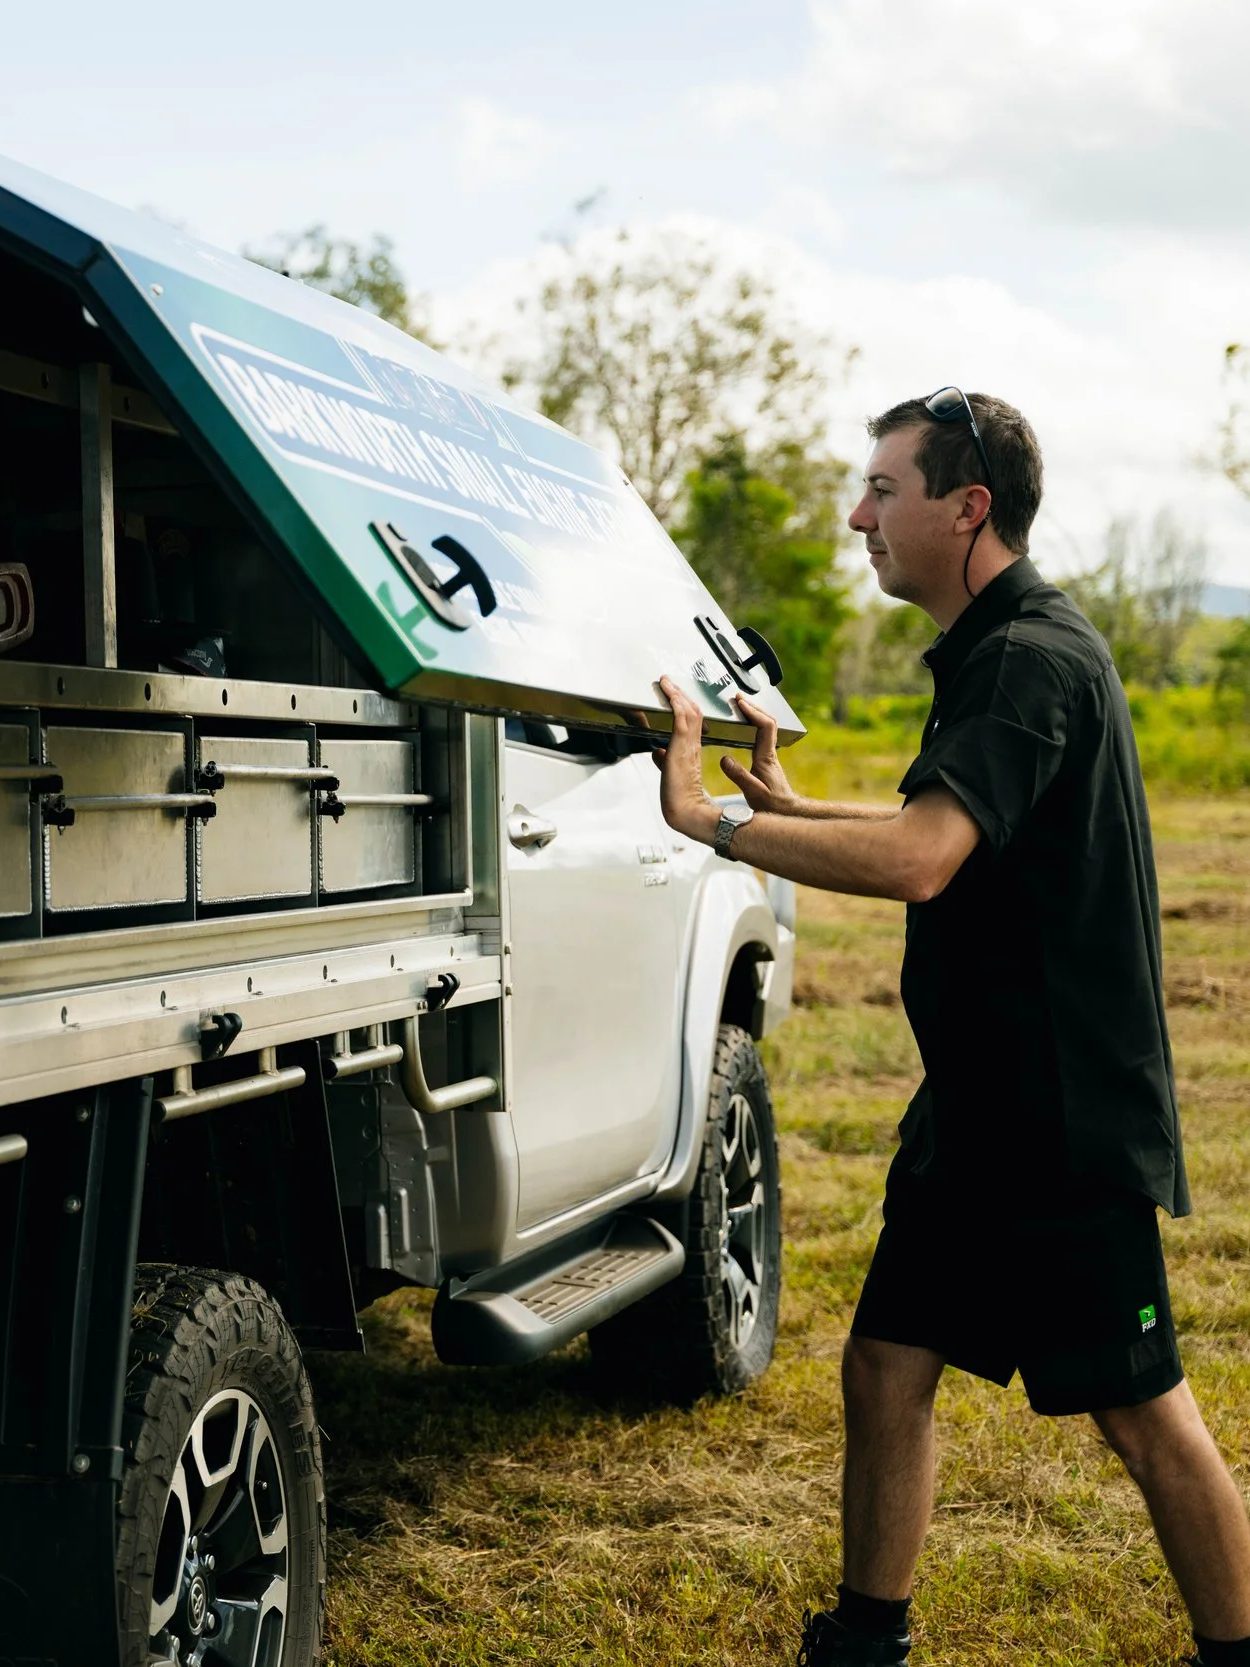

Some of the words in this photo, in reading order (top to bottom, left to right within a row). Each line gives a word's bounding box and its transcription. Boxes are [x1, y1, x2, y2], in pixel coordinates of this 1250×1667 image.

[217, 352, 450, 492] BARKWORTH
[418, 430, 533, 520] SMALL
[501, 463, 596, 542] ENGINE
